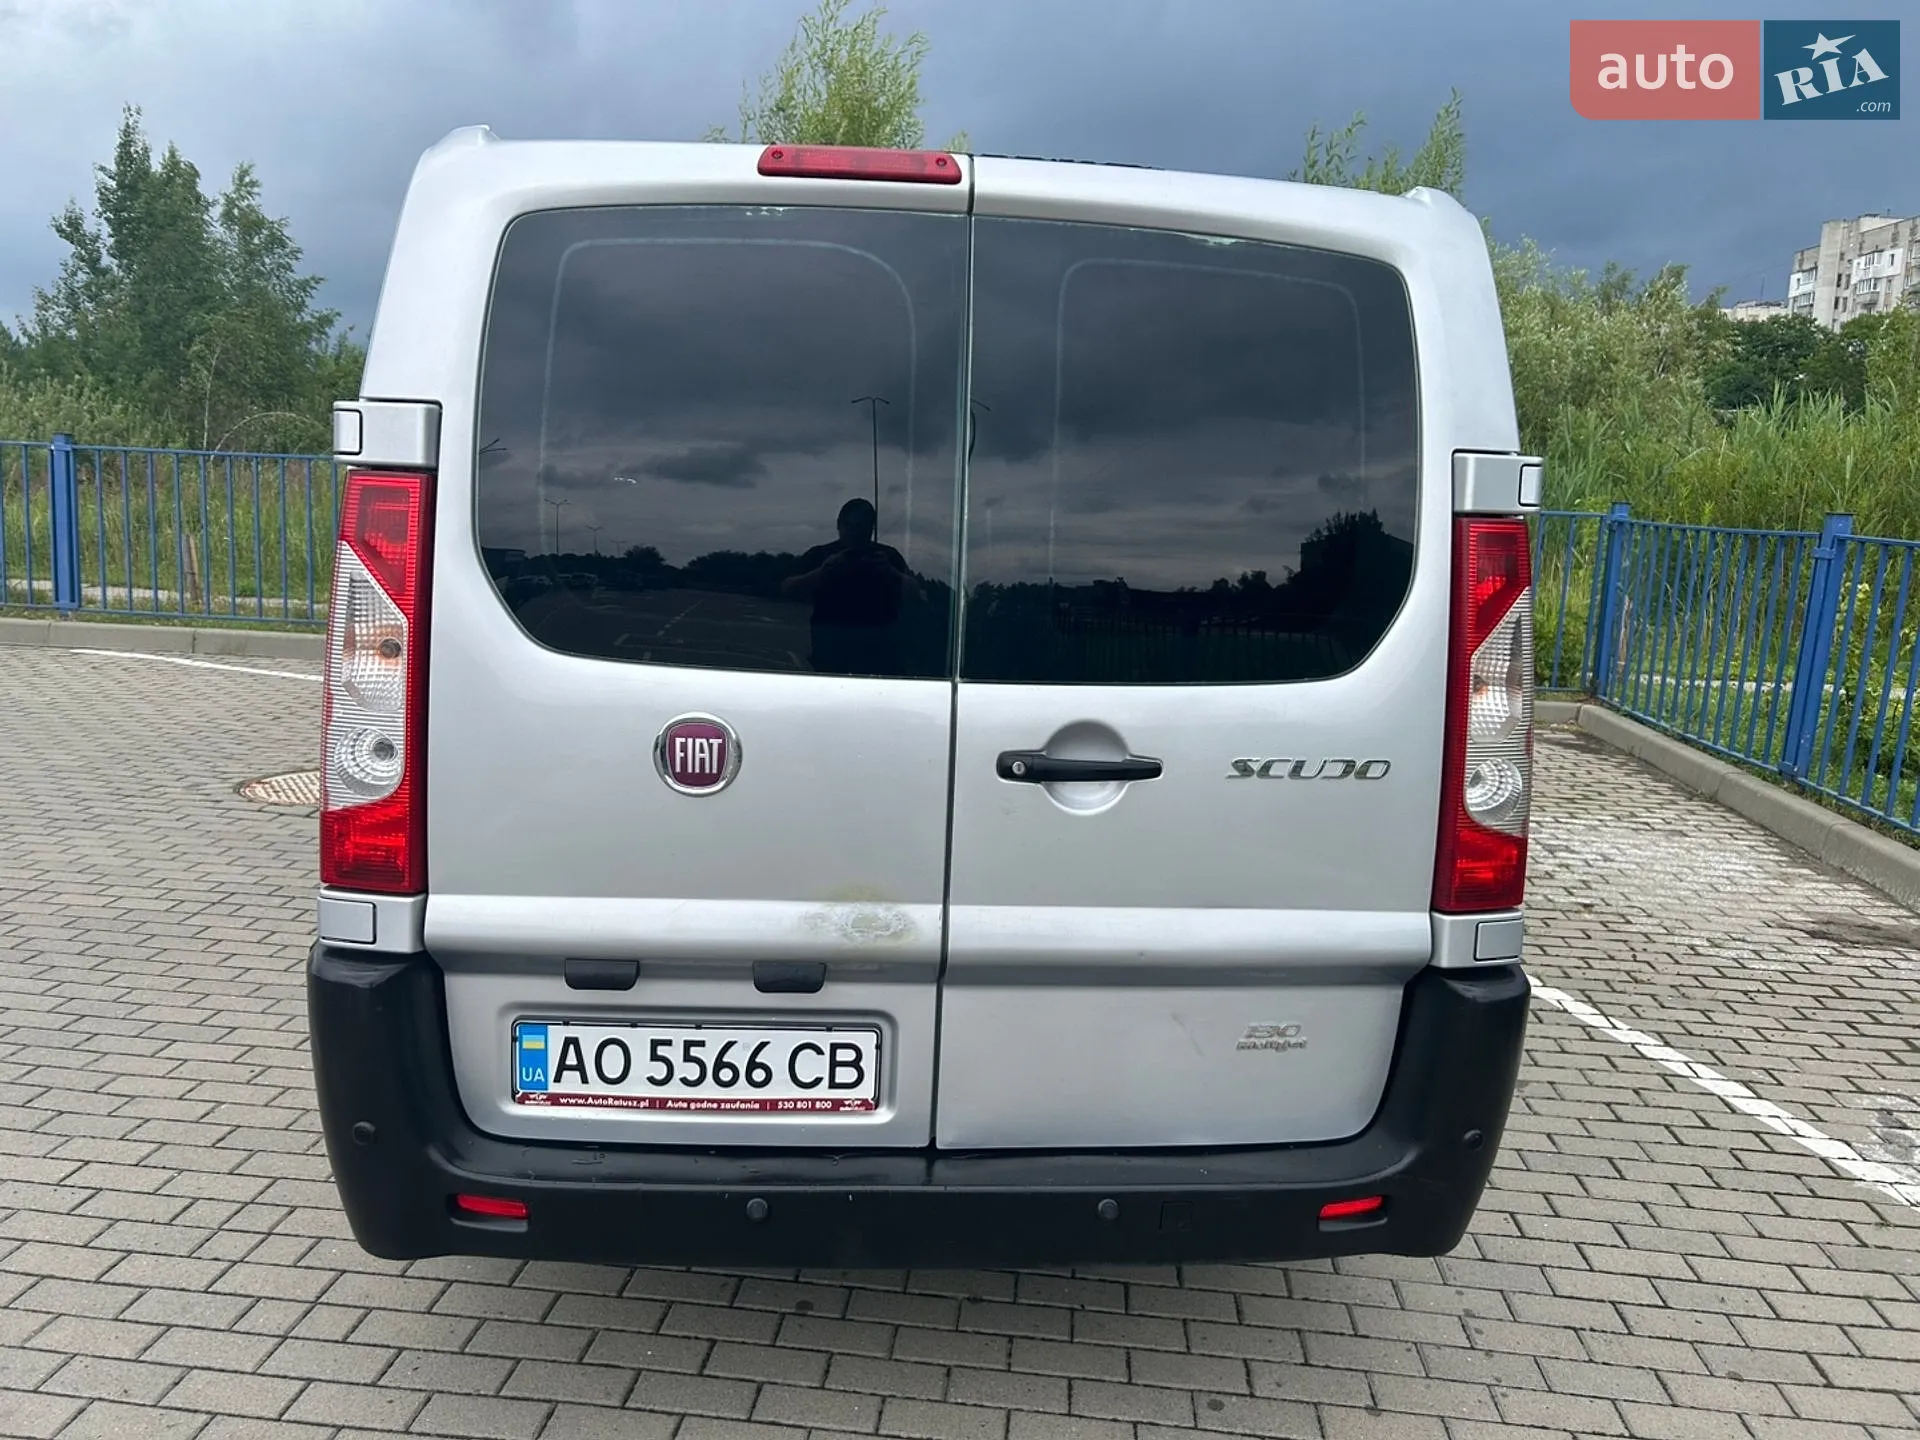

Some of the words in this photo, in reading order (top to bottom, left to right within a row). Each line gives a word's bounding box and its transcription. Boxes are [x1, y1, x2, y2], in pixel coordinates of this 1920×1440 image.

[674, 737, 723, 774] FIAT
[1226, 758, 1391, 779] SCUDO
[553, 1036, 632, 1085] AO
[646, 1038, 773, 1089] 5566
[788, 1042, 864, 1090] CB
[522, 1067, 545, 1082] UA
[777, 1100, 795, 1109] 530
[796, 1100, 812, 1109] 801
